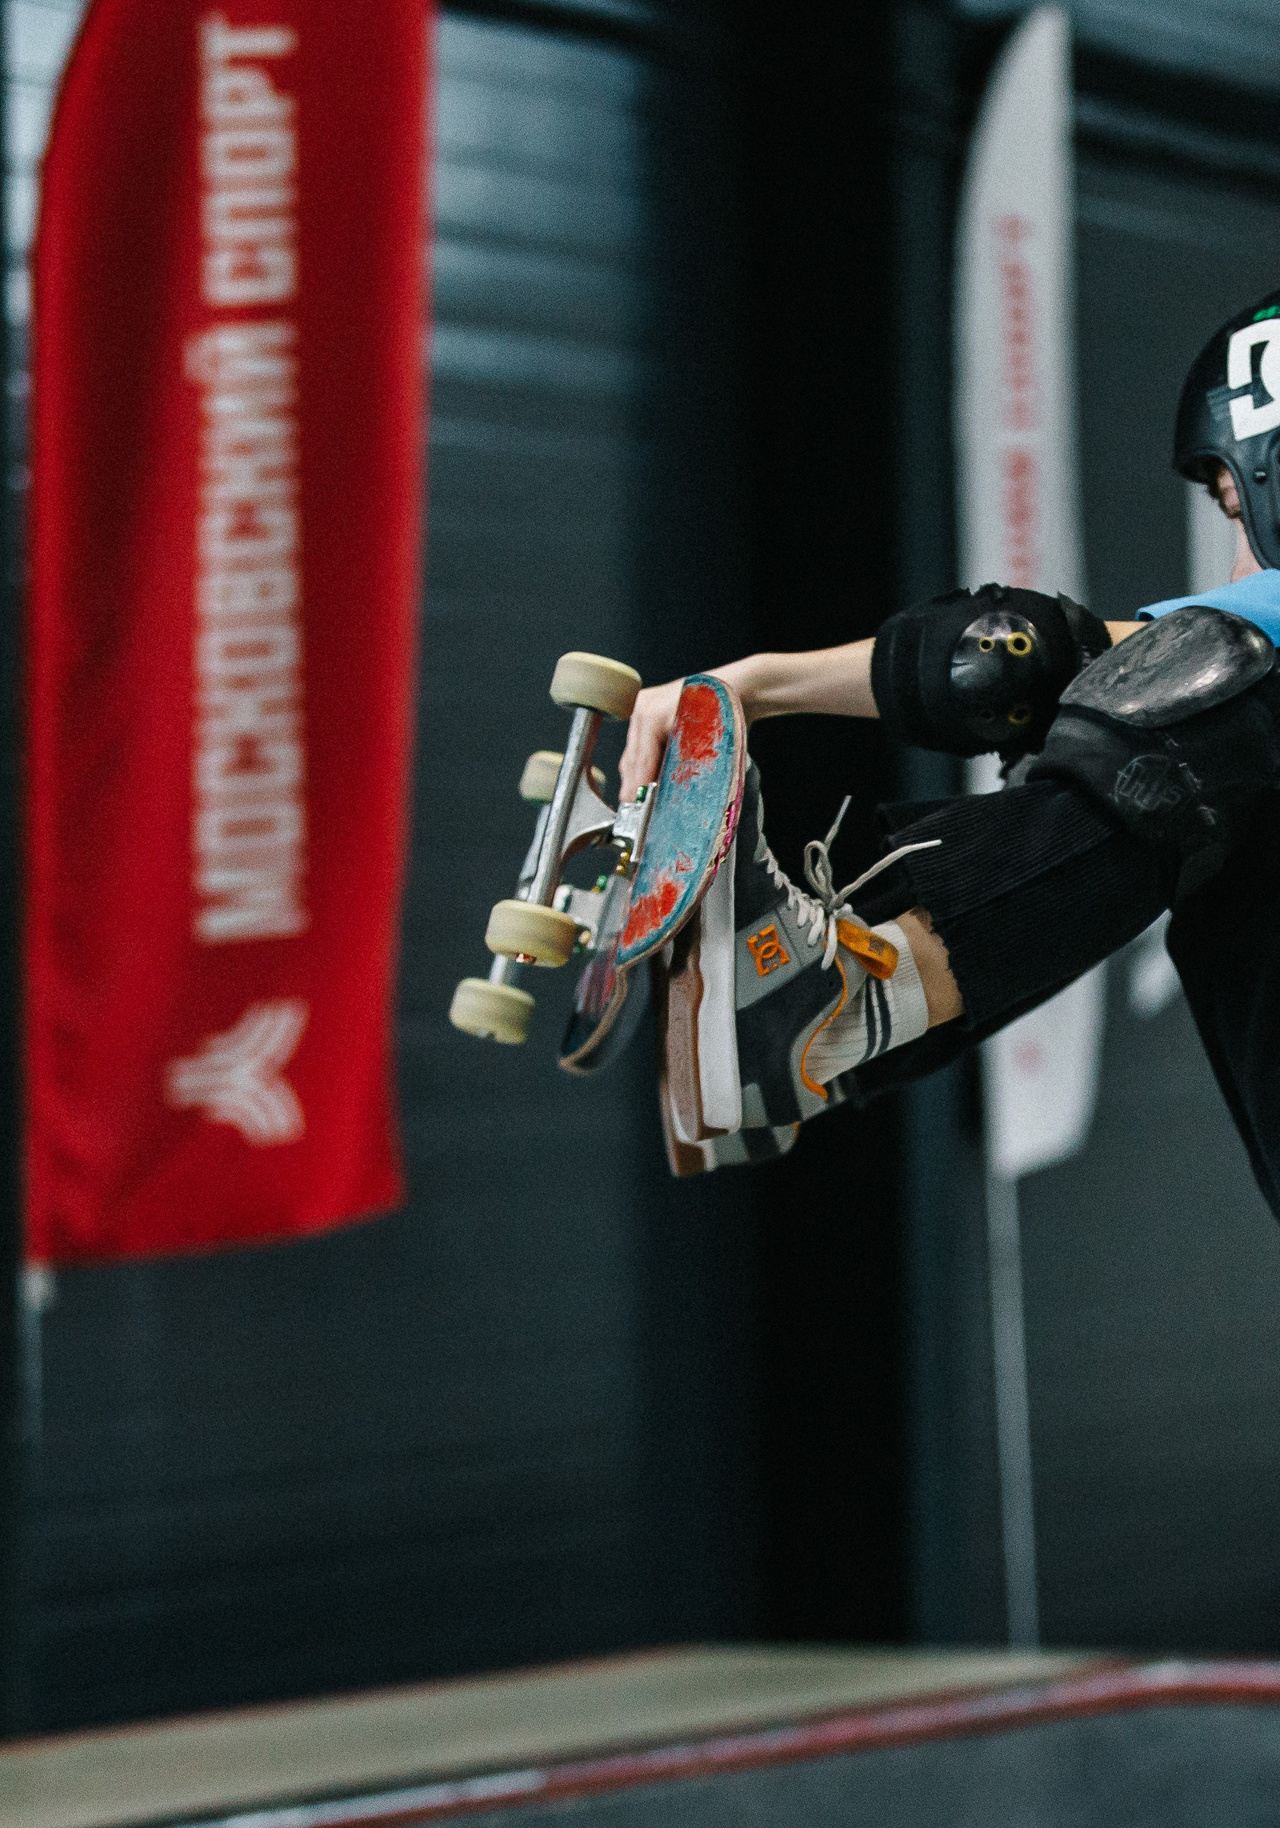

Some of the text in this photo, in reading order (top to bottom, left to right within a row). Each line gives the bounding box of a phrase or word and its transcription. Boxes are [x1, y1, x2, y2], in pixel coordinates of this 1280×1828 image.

[185, 12, 304, 943] МОСКОВСКИЙ СПОРТ
[747, 924, 790, 978] DC
